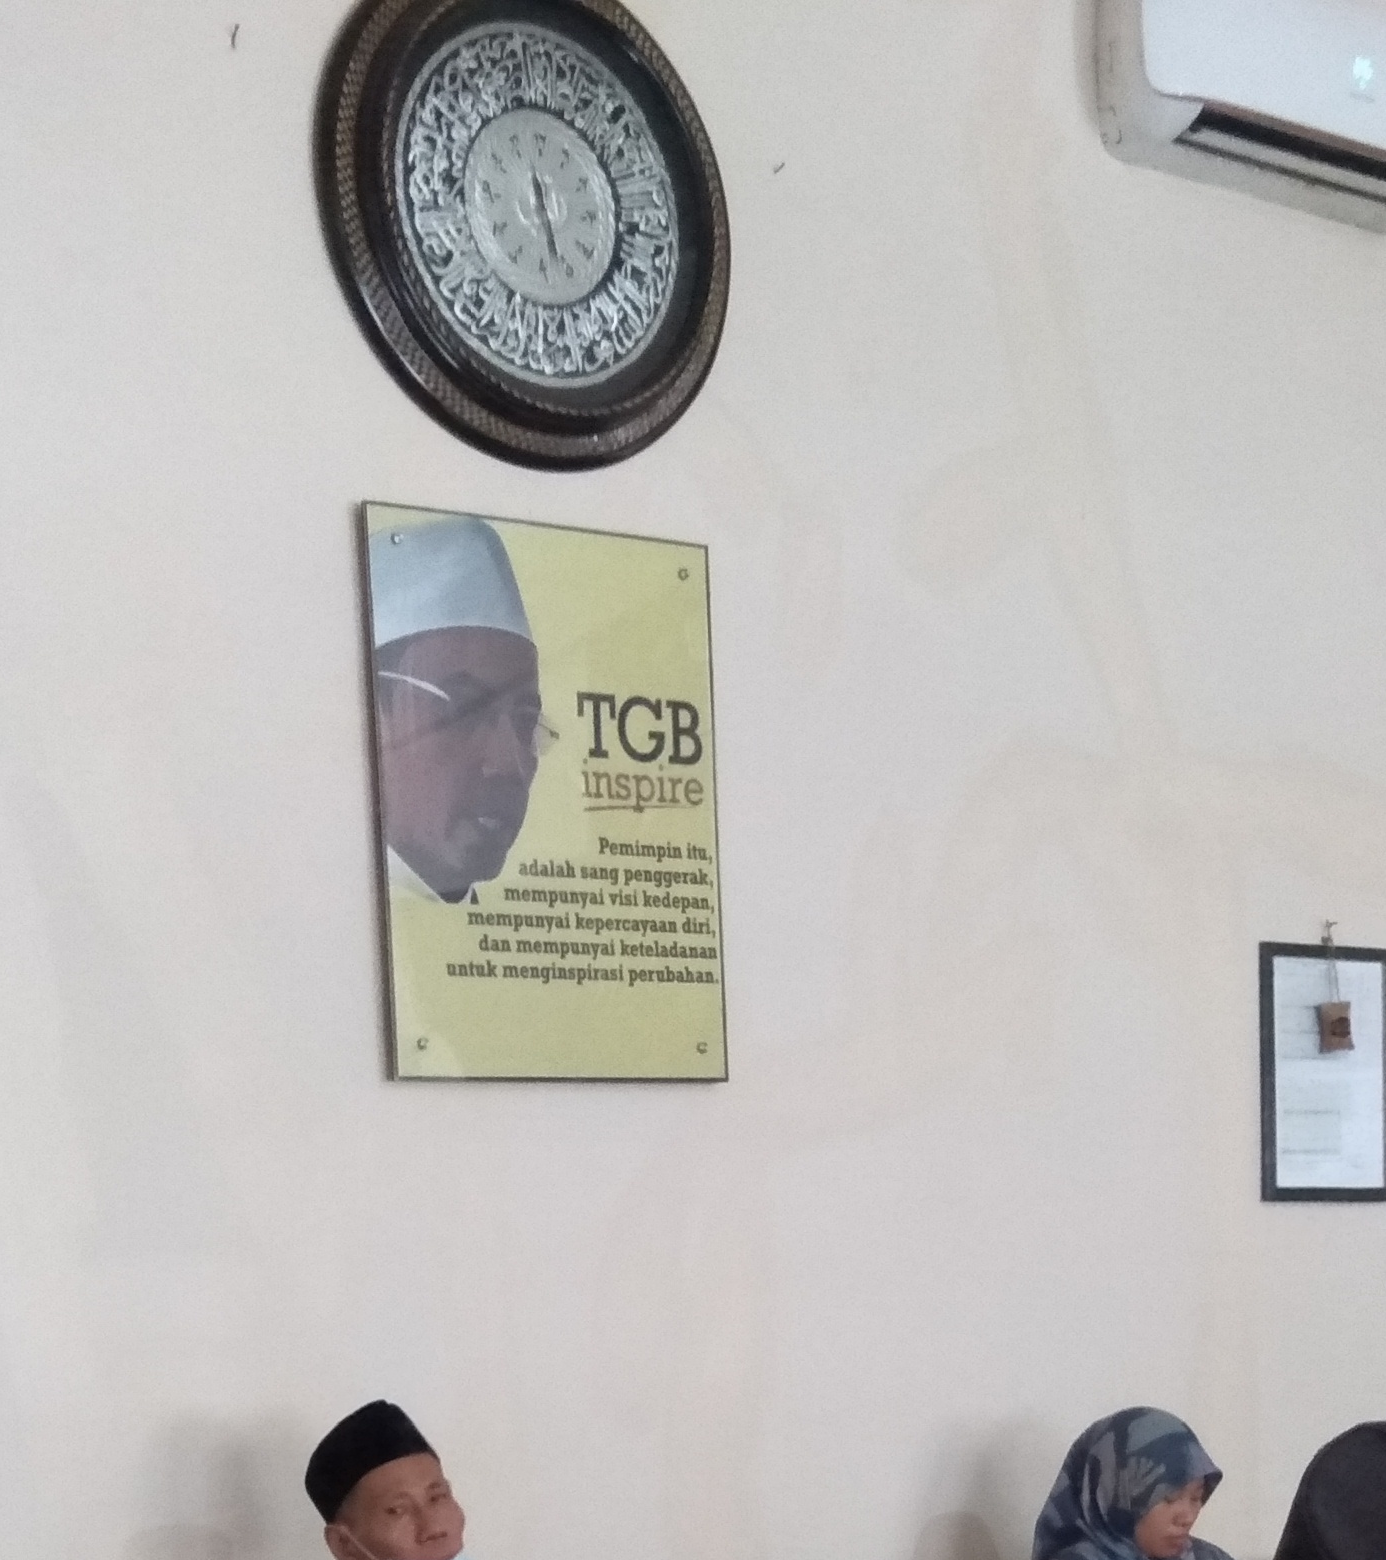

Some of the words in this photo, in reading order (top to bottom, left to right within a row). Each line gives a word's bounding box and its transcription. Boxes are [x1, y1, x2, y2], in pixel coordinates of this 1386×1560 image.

[577, 691, 703, 765] TGB
[581, 758, 704, 812] inspire
[598, 836, 682, 863] Pemimpin
[686, 841, 713, 864] itu,
[519, 860, 576, 879] adalah
[580, 866, 619, 885] sang
[624, 867, 714, 888] penggerak,
[504, 887, 605, 909] mempunyai
[609, 889, 638, 906] visi
[643, 890, 714, 914] kedepan,
[467, 911, 570, 932] mempunyai
[575, 912, 677, 936] kepercayaan
[682, 917, 716, 938] diri,
[479, 934, 511, 952] dan
[516, 937, 615, 959] mempunyai
[620, 938, 717, 959] keteladanan
[447, 960, 497, 978] untuk
[503, 963, 623, 984] menginspirasi
[628, 965, 720, 986] perubahan.
